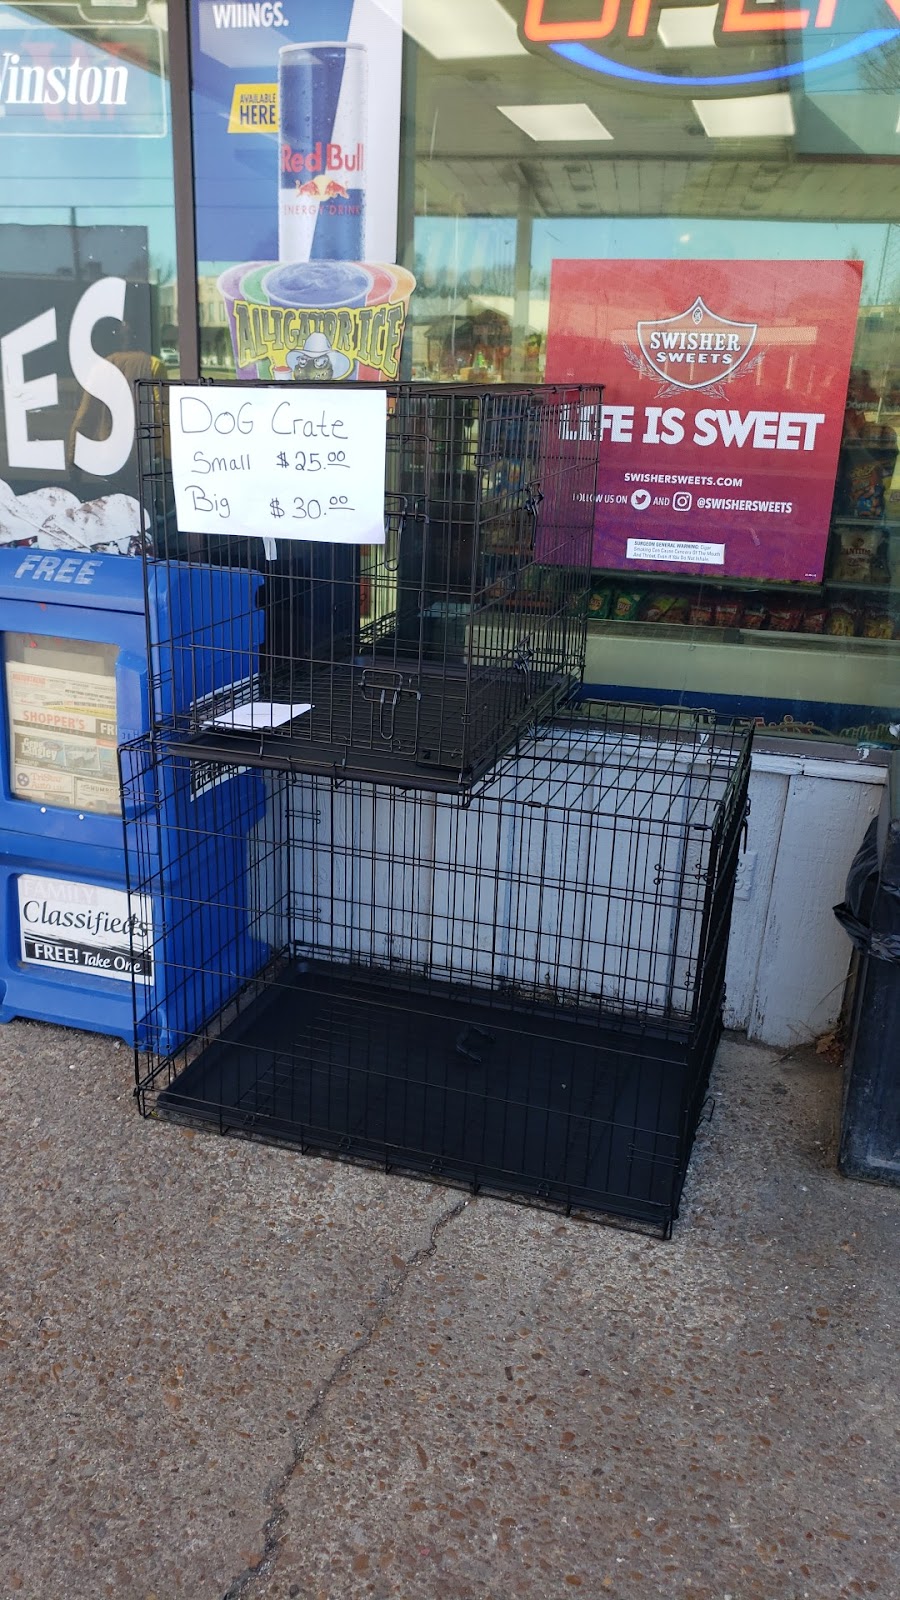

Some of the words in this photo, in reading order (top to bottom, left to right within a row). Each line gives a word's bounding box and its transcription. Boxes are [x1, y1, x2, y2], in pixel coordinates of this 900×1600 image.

[211, 1, 290, 30] WIIINGS.
[0, 52, 129, 106] inston
[239, 93, 276, 104] AVAILABLE
[239, 104, 276, 125] HERE
[281, 141, 322, 173] Red
[326, 143, 364, 172] Bull
[284, 204, 325, 216] ENERGY
[328, 204, 362, 216] DRINK
[650, 331, 741, 352] SWISHER
[656, 352, 733, 365] SWEETS
[271, 401, 348, 440] Crate
[643, 406, 686, 445] IS
[693, 408, 826, 451] SWEET
[191, 450, 251, 475] Small
[624, 472, 743, 488] SWISHERSWEETS.COM
[184, 485, 231, 519] Big
[604, 494, 615, 504] US
[615, 494, 628, 505] ON
[652, 496, 670, 507] AND
[697, 497, 793, 514] @SWISHERSWEETS
[14, 554, 104, 586] FREE
[23, 710, 86, 731] SHOPPER'S
[100, 722, 117, 738] FR
[23, 878, 94, 905] FAMILY
[23, 900, 149, 938] Classifieds
[34, 943, 79, 964] FREE!
[81, 951, 112, 970] Take
[113, 955, 142, 974] One
